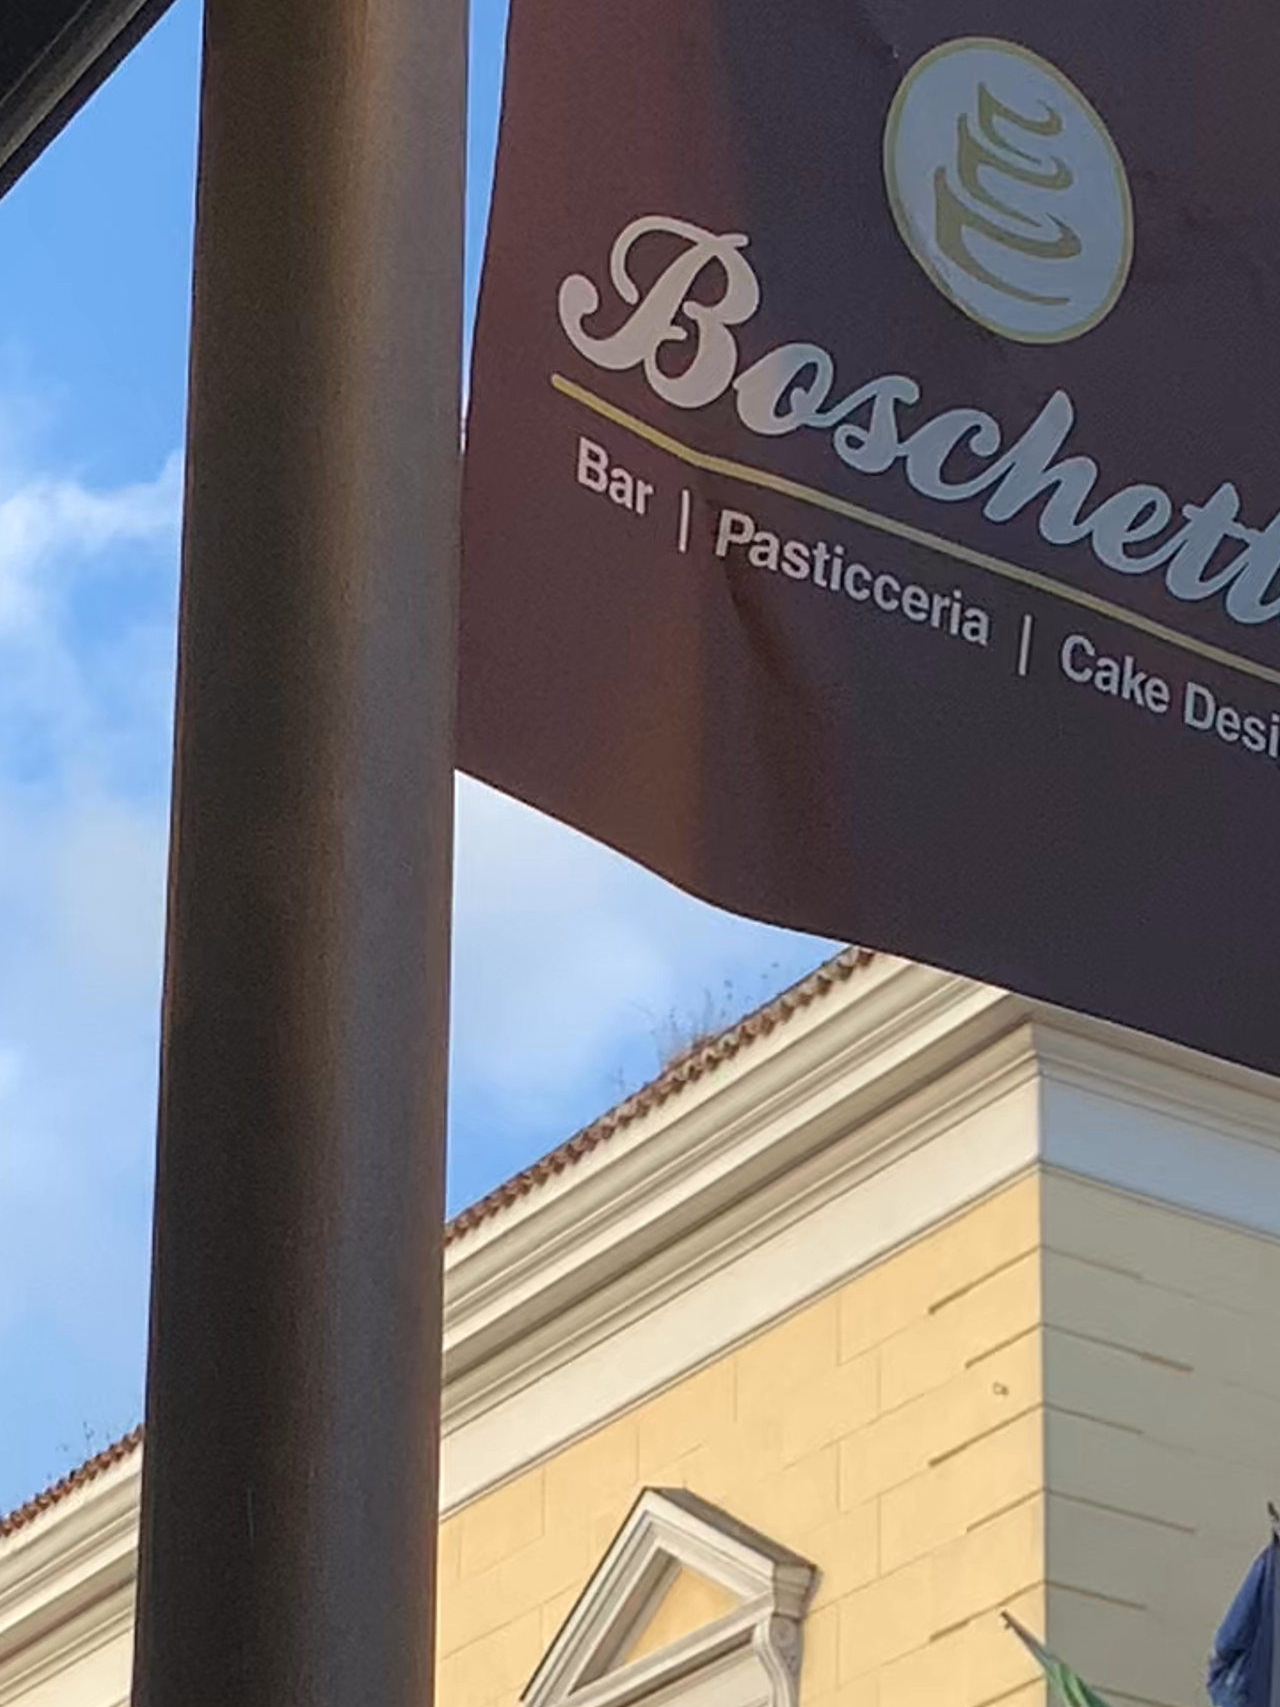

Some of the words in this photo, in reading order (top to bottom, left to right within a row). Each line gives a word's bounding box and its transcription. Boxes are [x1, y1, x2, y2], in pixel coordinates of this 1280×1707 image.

[577, 436, 654, 516] Bar
[715, 508, 990, 647] Pasticceria
[1060, 634, 1171, 714] Cake
